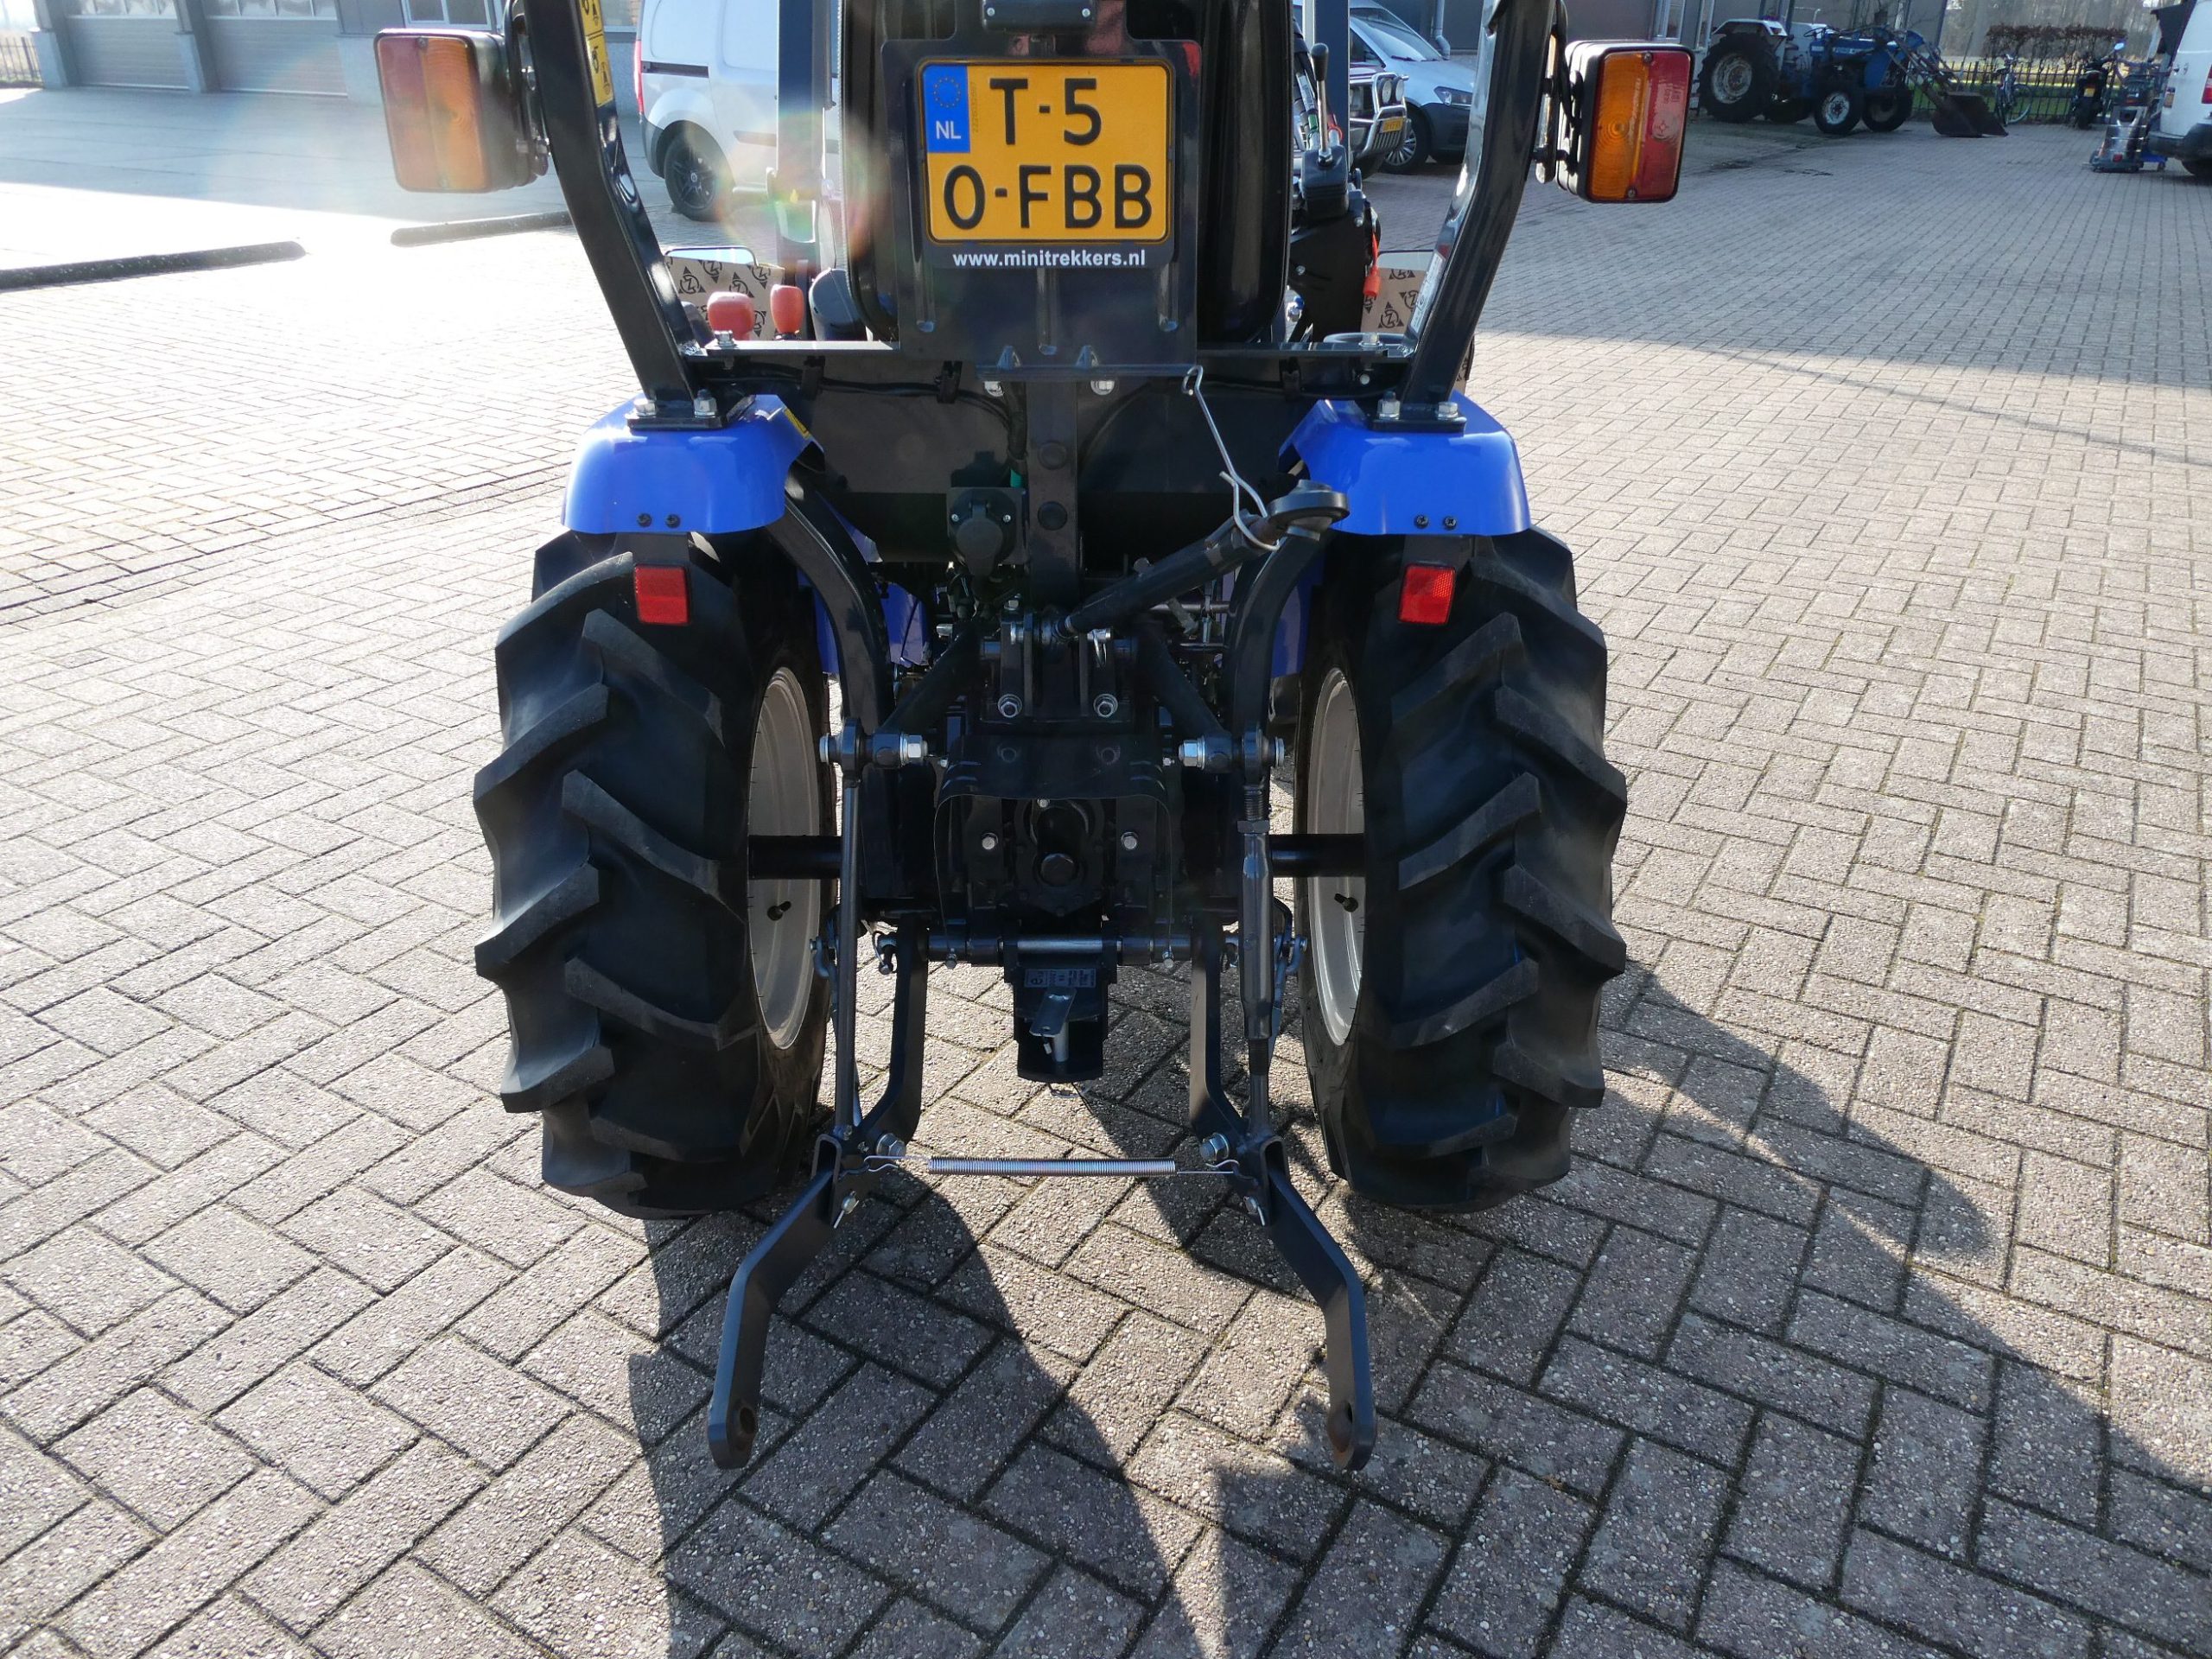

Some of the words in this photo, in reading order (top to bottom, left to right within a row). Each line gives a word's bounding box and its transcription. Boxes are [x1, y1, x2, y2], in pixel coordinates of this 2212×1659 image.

[989, 78, 1102, 146] T-5
[936, 120, 962, 140] NL
[952, 250, 1146, 267] www.minitrekkers.nl
